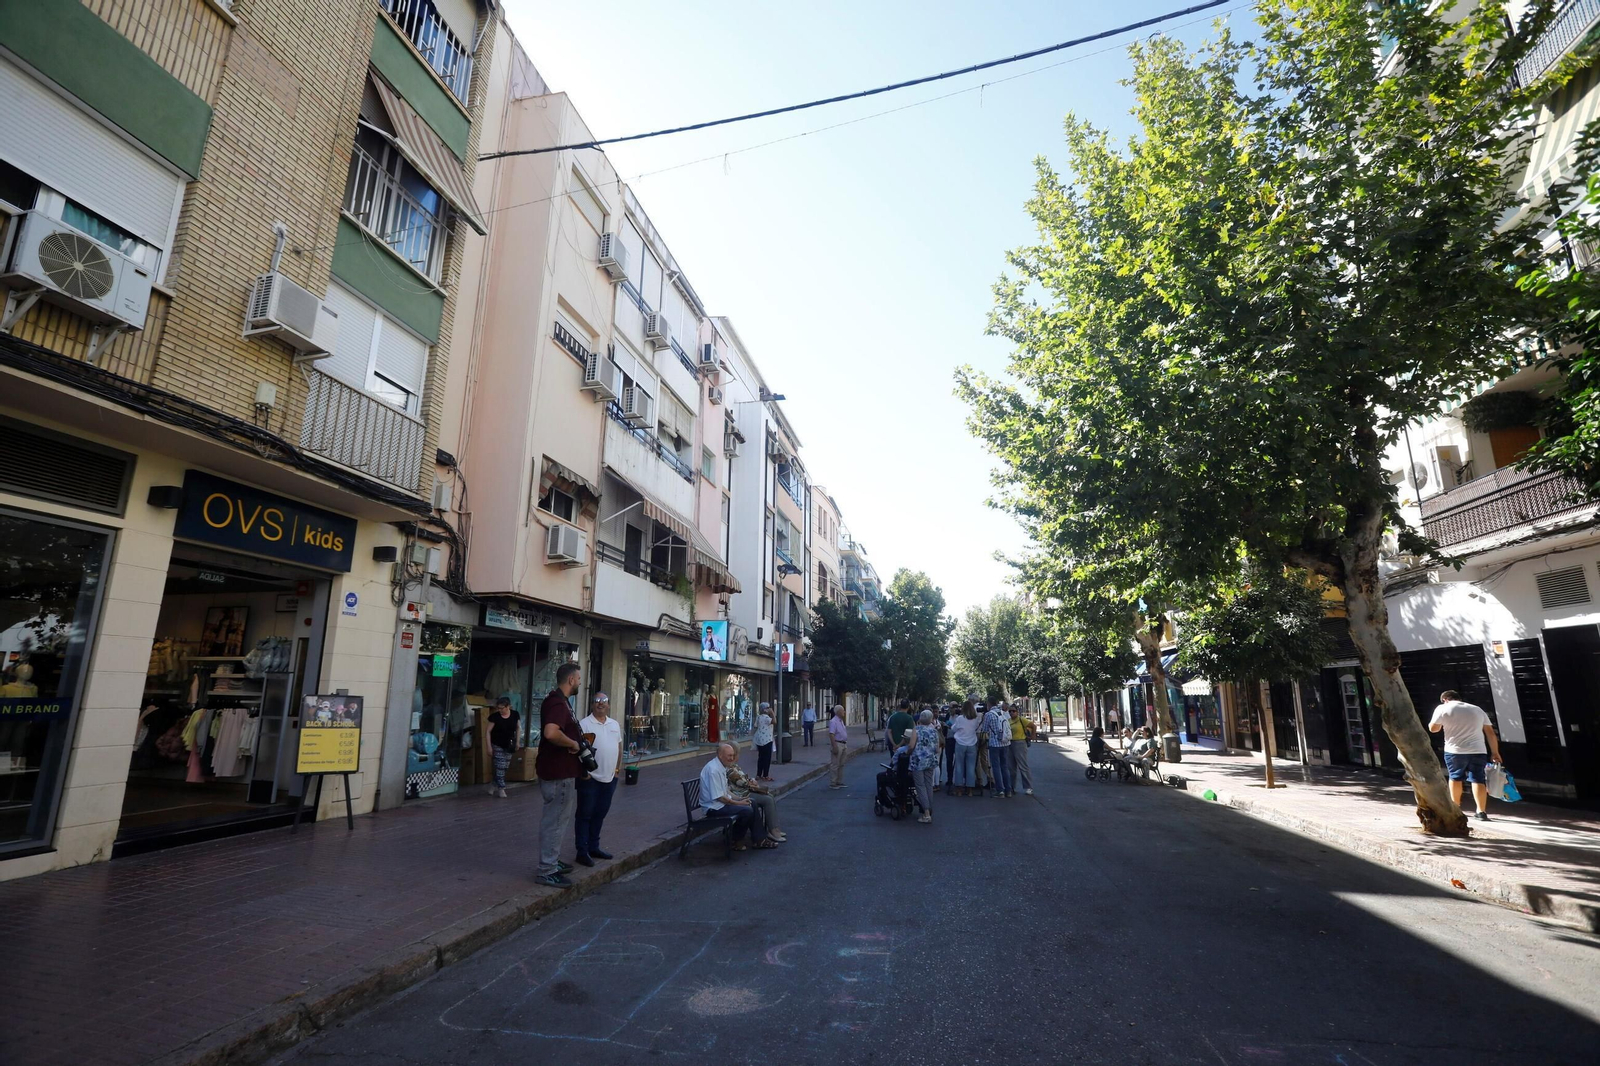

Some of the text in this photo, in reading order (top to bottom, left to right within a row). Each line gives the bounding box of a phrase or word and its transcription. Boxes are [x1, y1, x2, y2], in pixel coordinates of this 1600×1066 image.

[203, 493, 344, 552] OVS kids
[15, 704, 60, 714] BRAND
[324, 720, 332, 728] TO
[333, 720, 356, 728] SCHOOL
